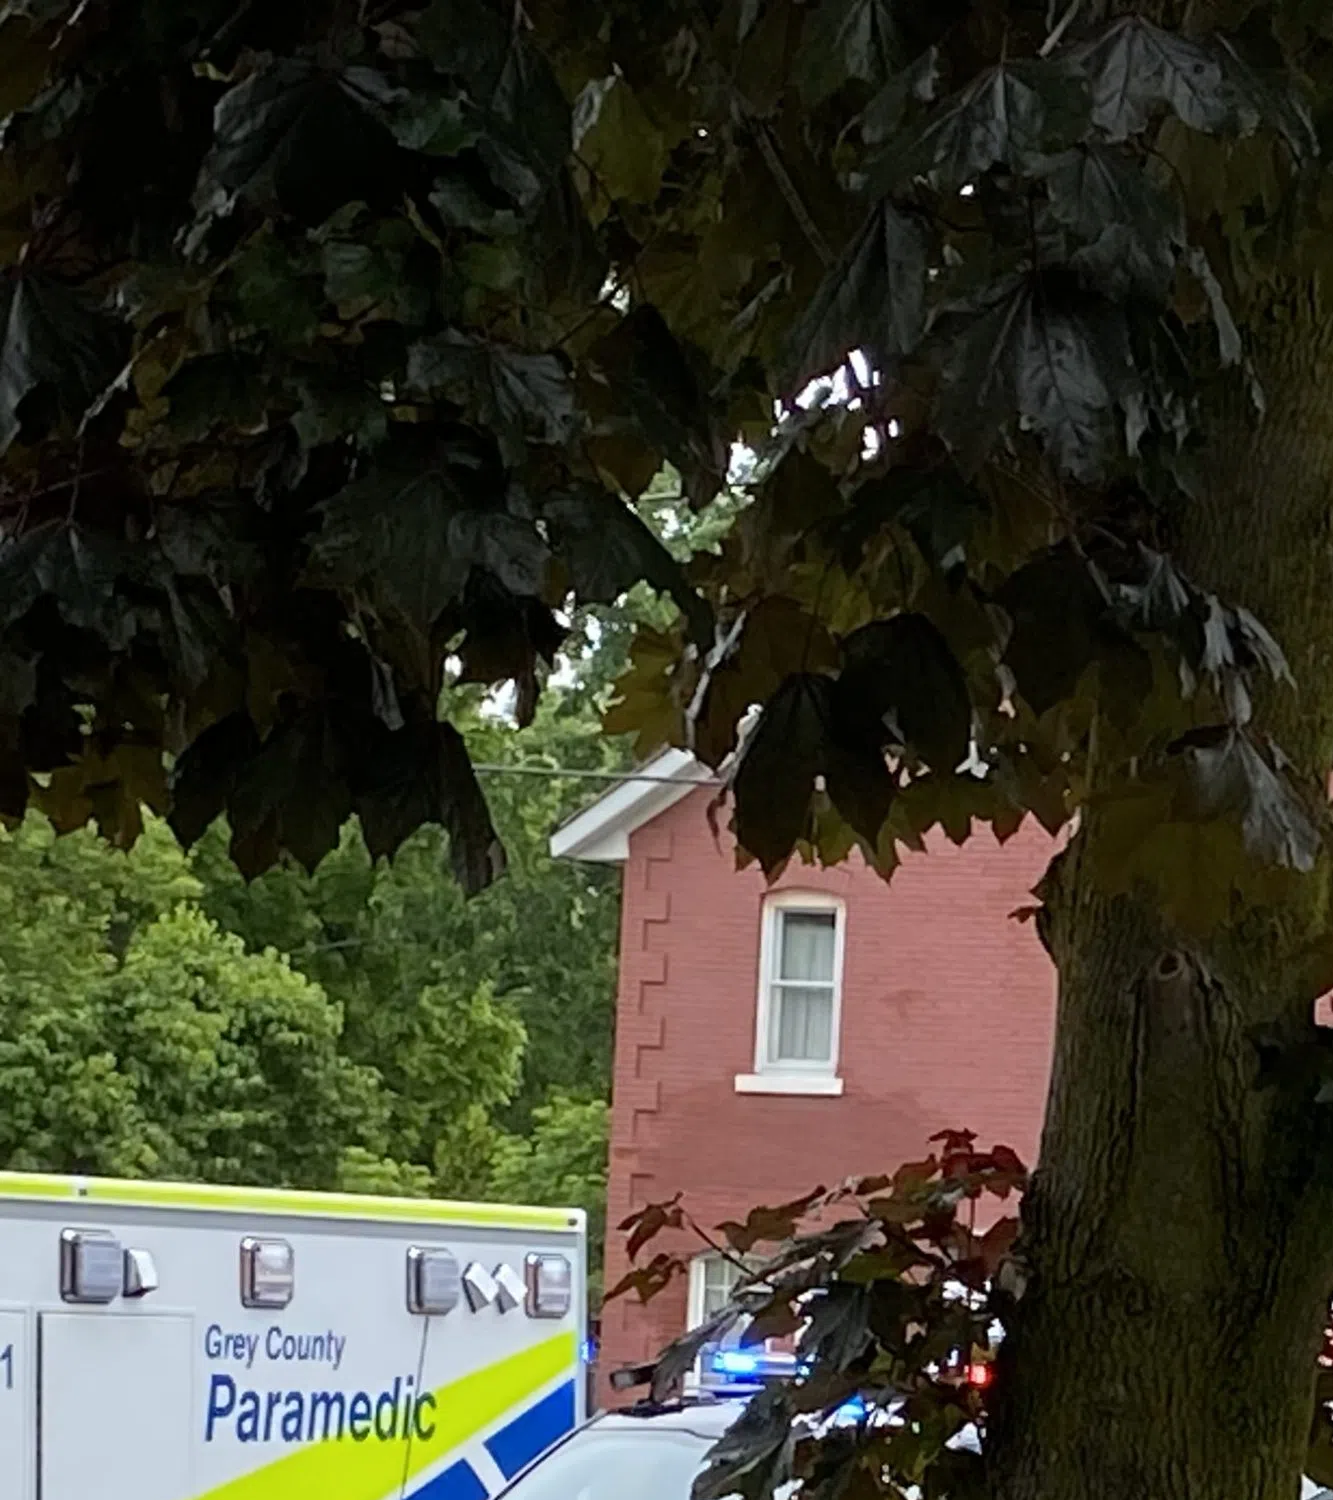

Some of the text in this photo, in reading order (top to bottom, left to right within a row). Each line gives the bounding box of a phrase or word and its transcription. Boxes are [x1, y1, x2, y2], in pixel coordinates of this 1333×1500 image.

[205, 1324, 346, 1369] Grey County
[205, 1374, 437, 1442] Paramedic
